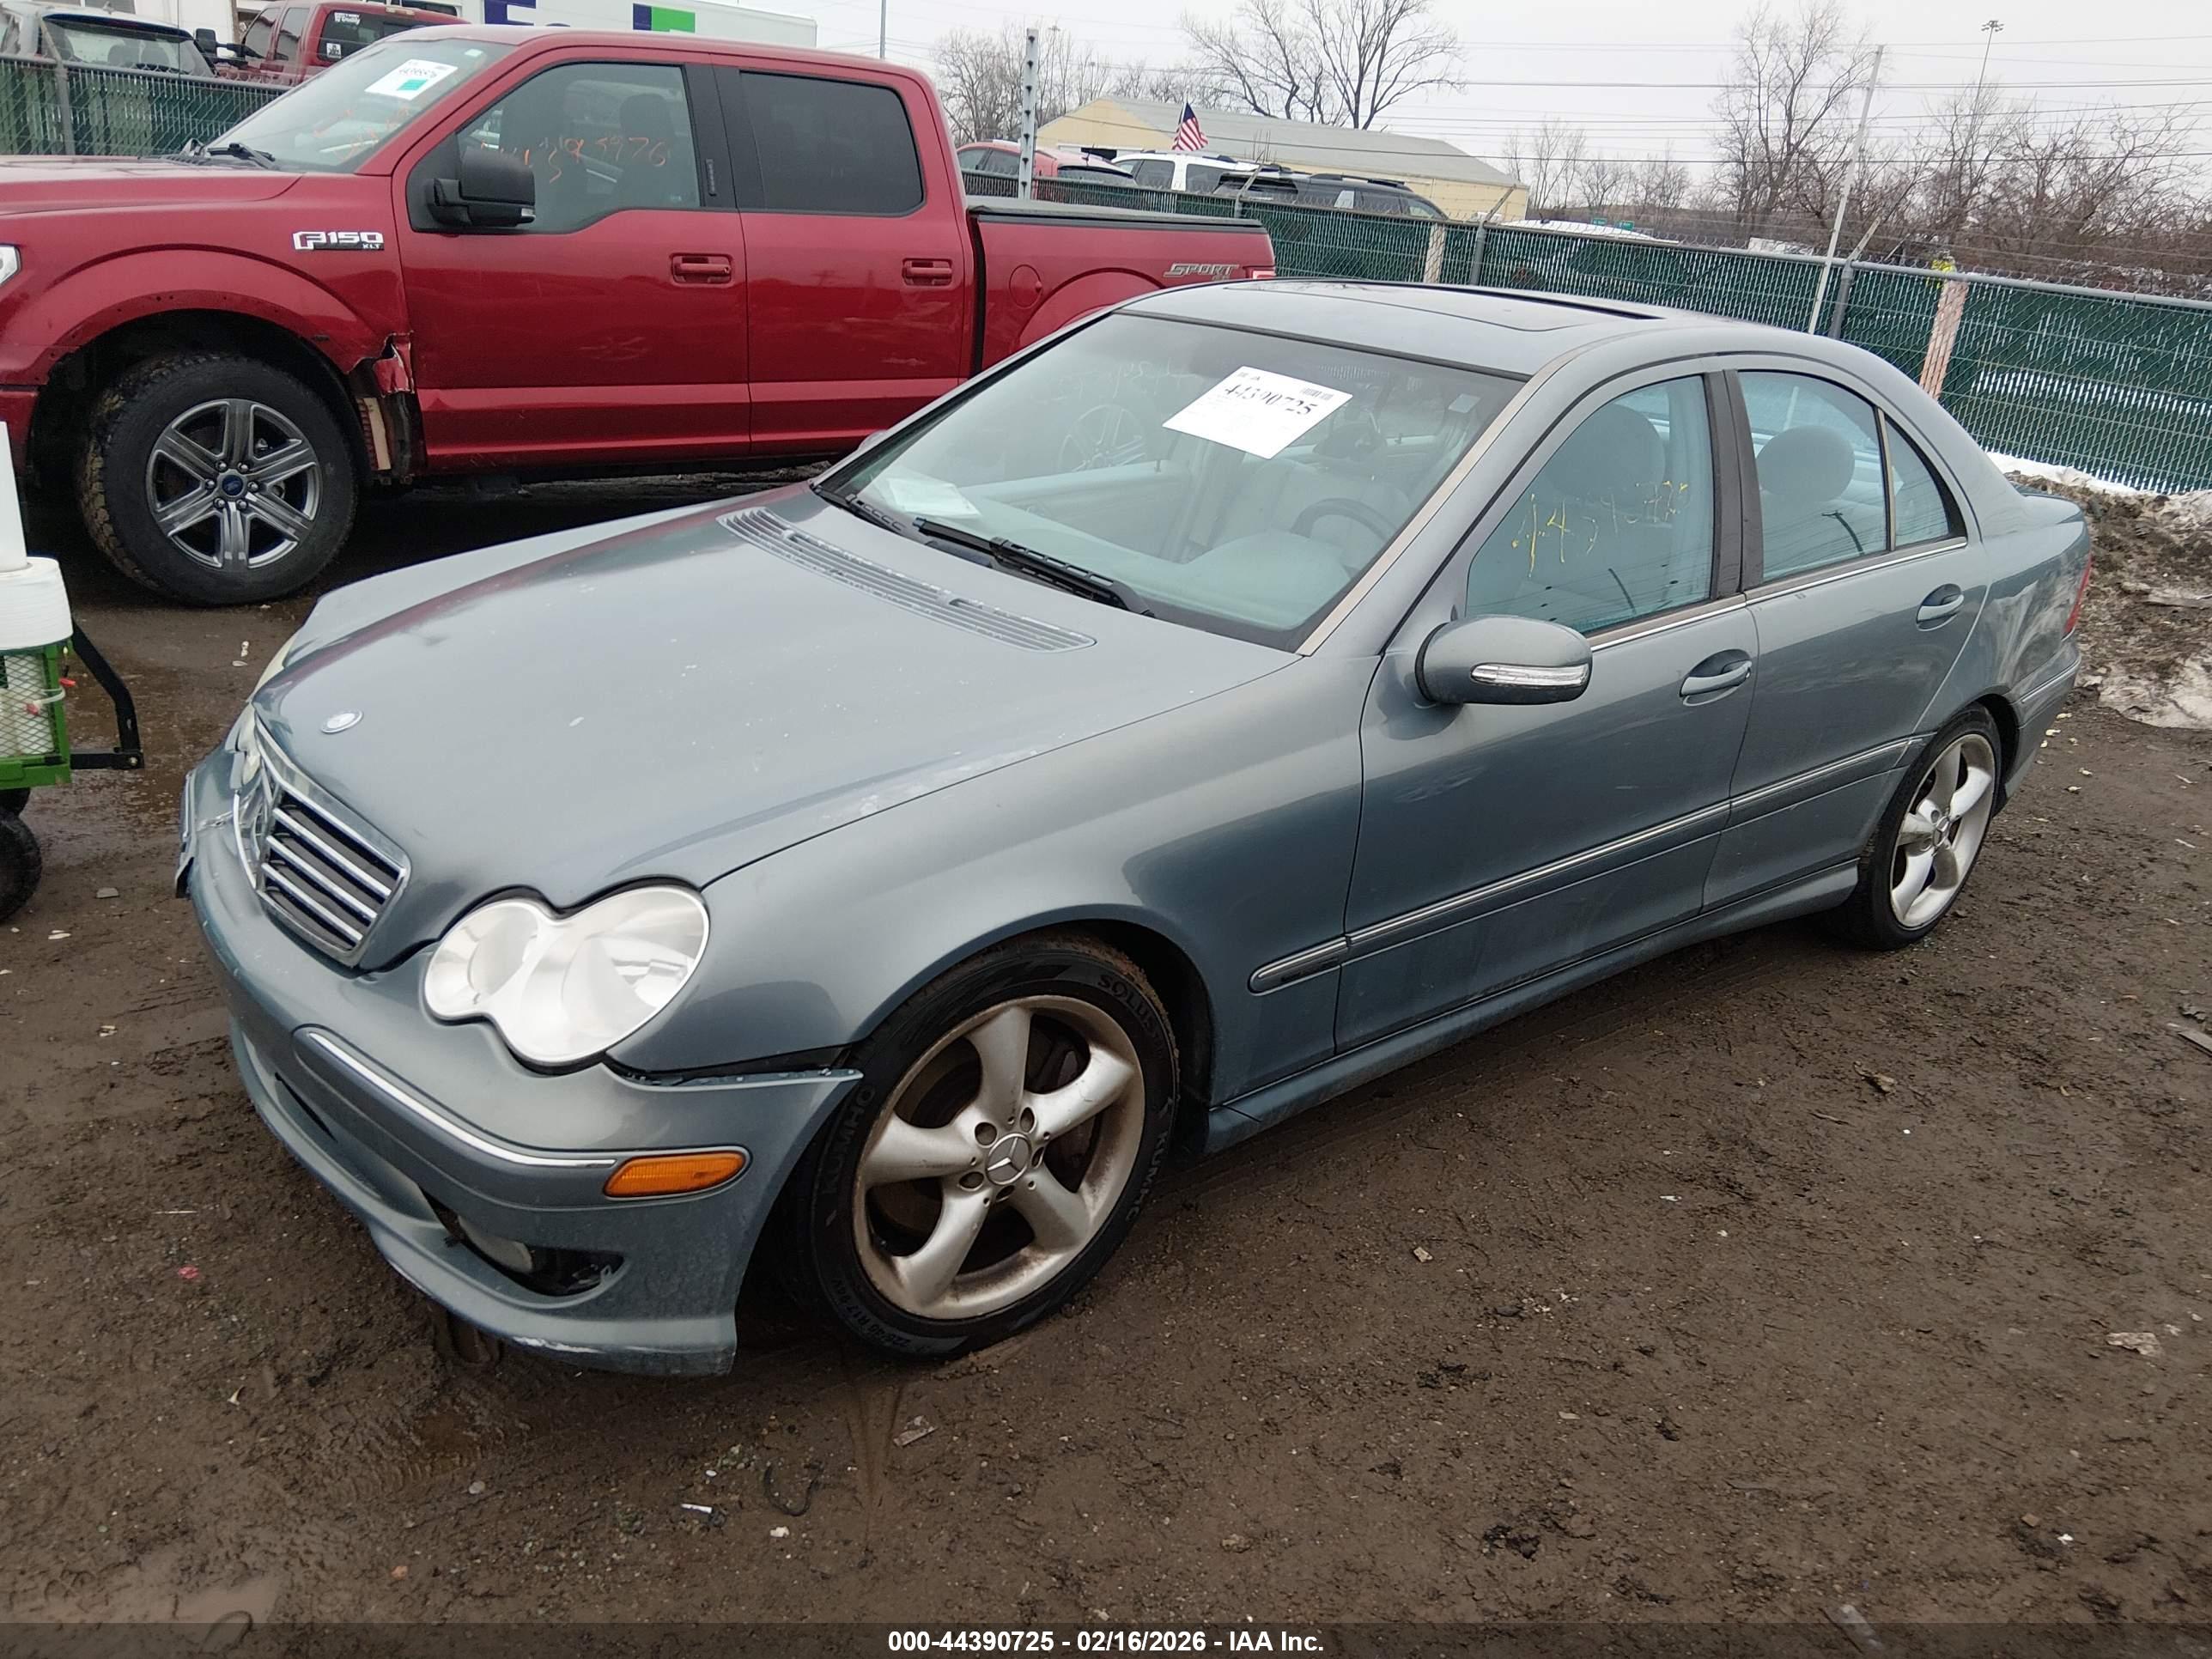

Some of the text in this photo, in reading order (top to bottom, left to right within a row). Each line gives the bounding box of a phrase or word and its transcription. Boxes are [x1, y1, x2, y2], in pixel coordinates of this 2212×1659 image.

[1162, 263, 1240, 277] SPORT
[1097, 974, 1157, 1031] SOLUS
[822, 1087, 876, 1194] KUMHO
